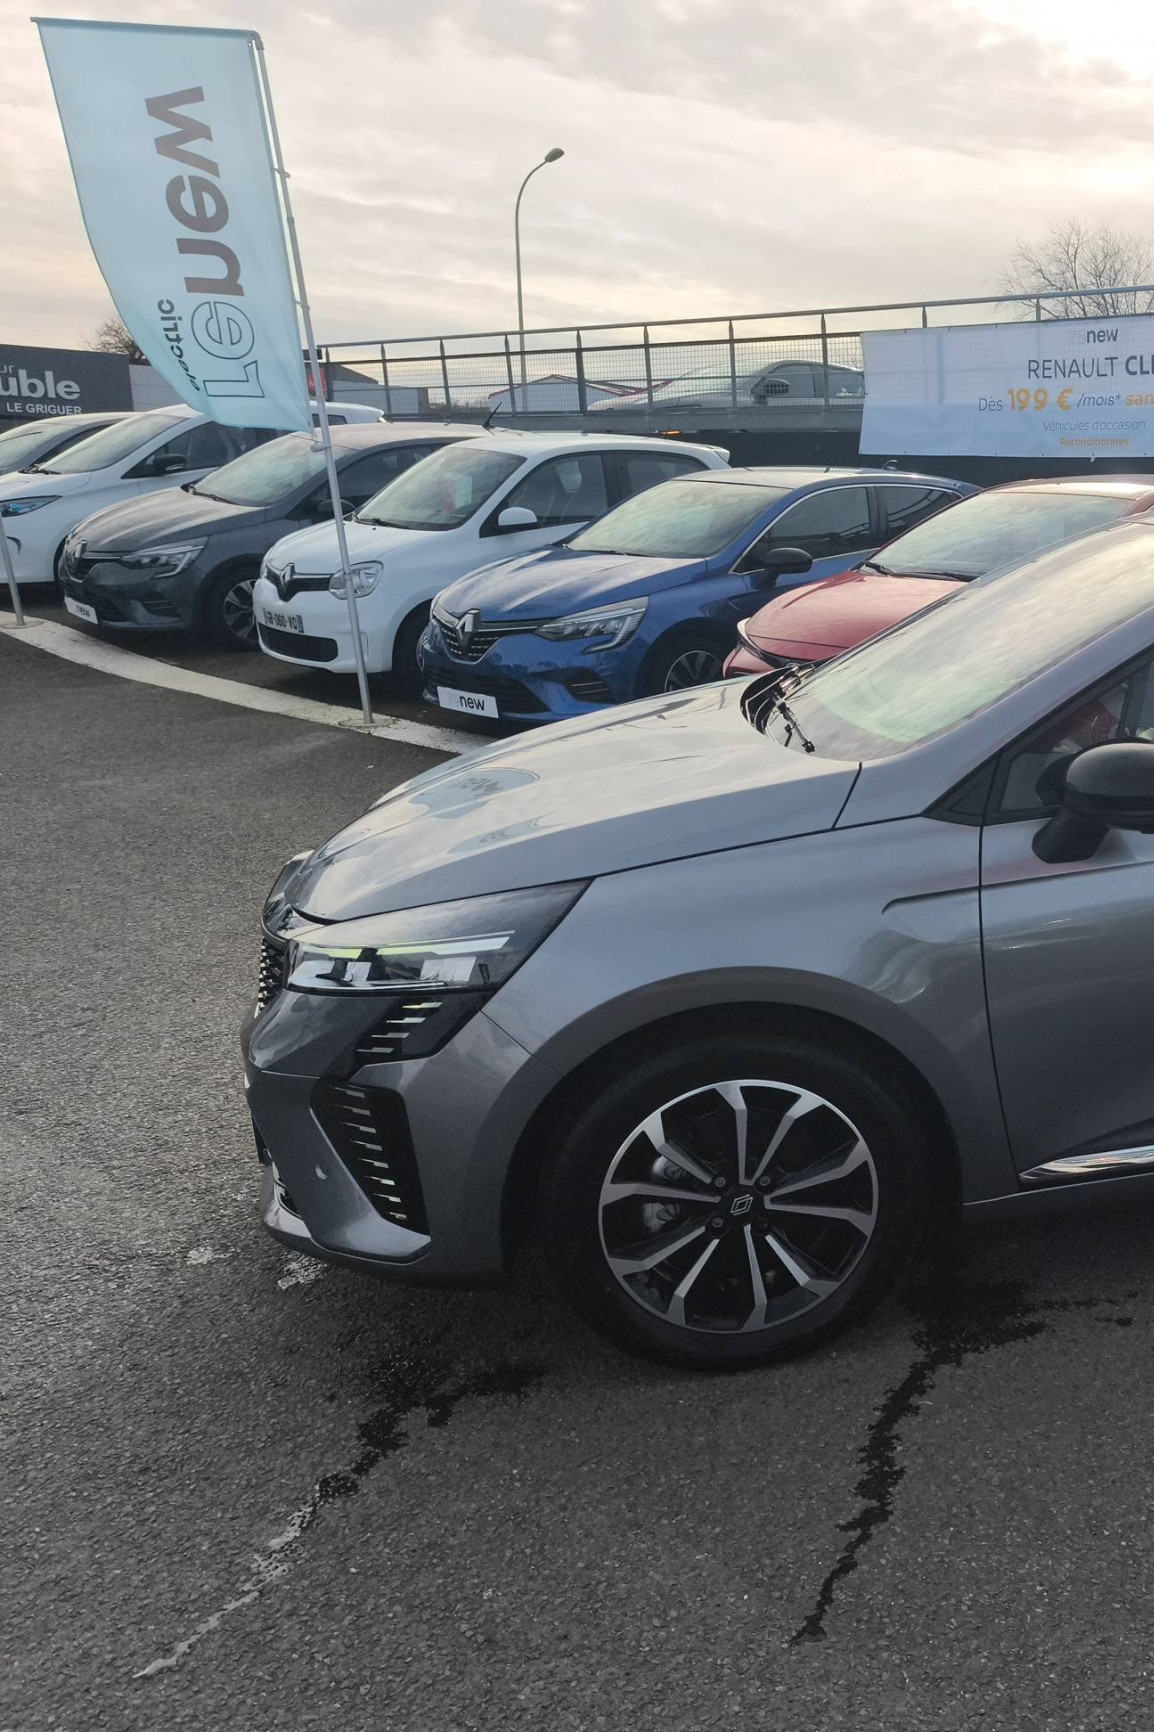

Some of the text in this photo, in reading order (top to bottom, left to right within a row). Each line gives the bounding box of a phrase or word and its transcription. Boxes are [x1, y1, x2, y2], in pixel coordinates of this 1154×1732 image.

[1027, 357, 1119, 379] RENAULT
[6, 402, 82, 415] LE GRIGUER
[978, 396, 1003, 412] Dès
[1007, 387, 1049, 411] 199
[1056, 387, 1074, 411] €
